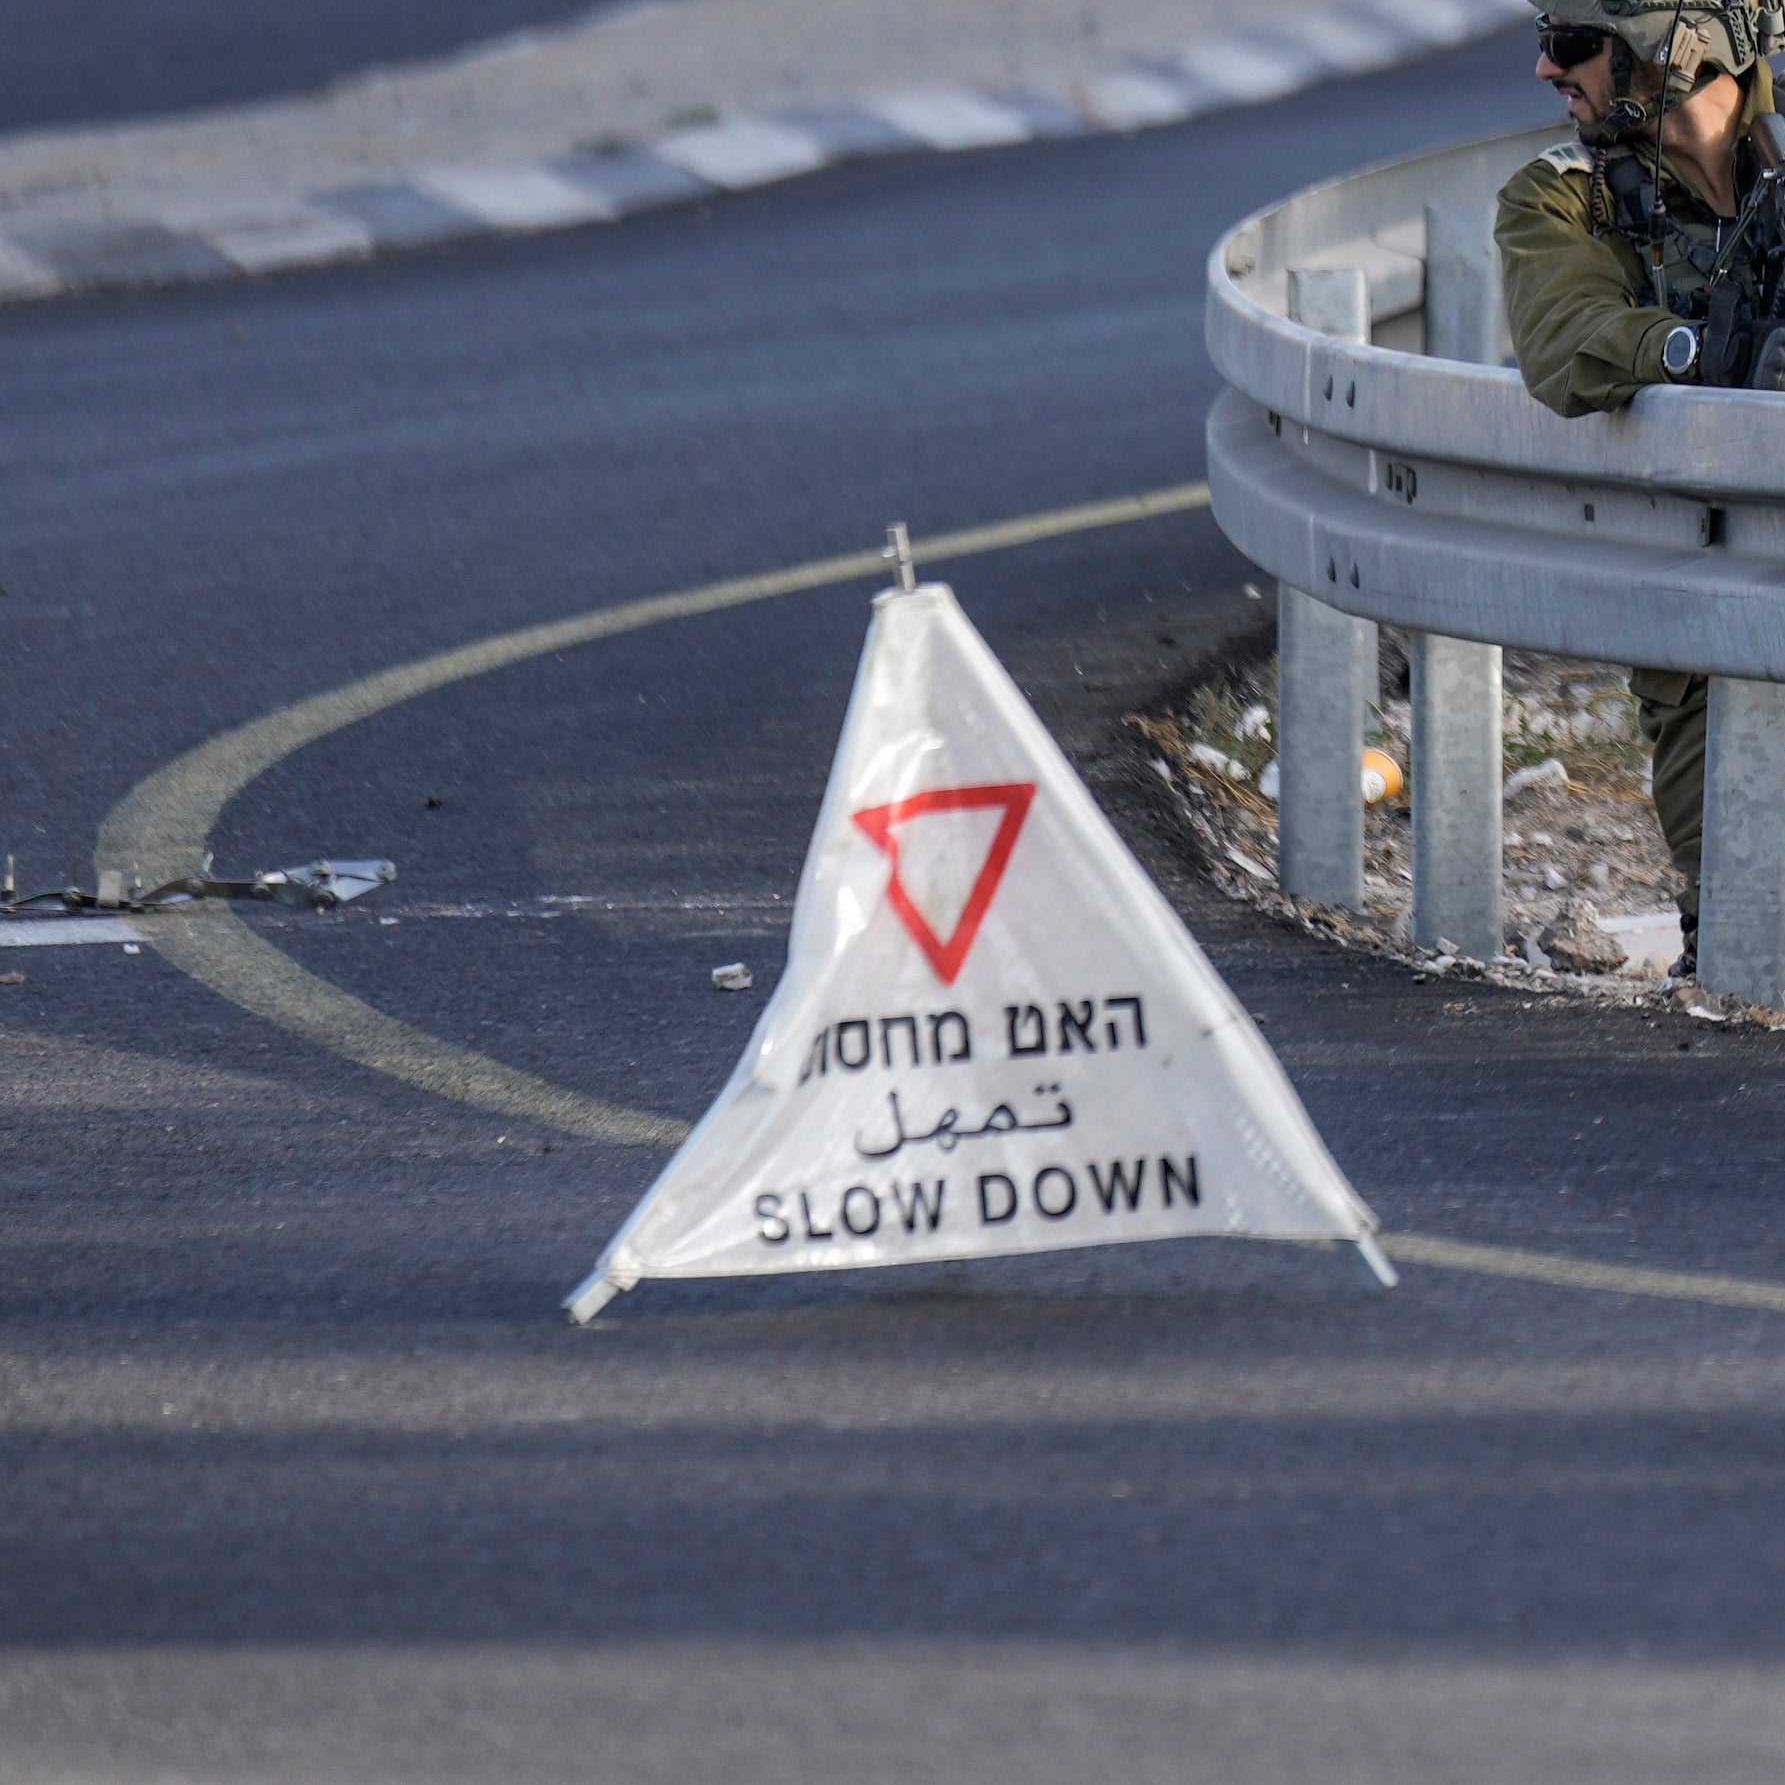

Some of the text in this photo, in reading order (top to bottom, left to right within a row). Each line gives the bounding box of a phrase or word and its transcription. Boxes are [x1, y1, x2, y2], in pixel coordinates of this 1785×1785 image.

[1004, 996, 1148, 1060] האט
[854, 1081, 1074, 1160] تمهل
[754, 1152, 1202, 1244] SLOW DOWN
